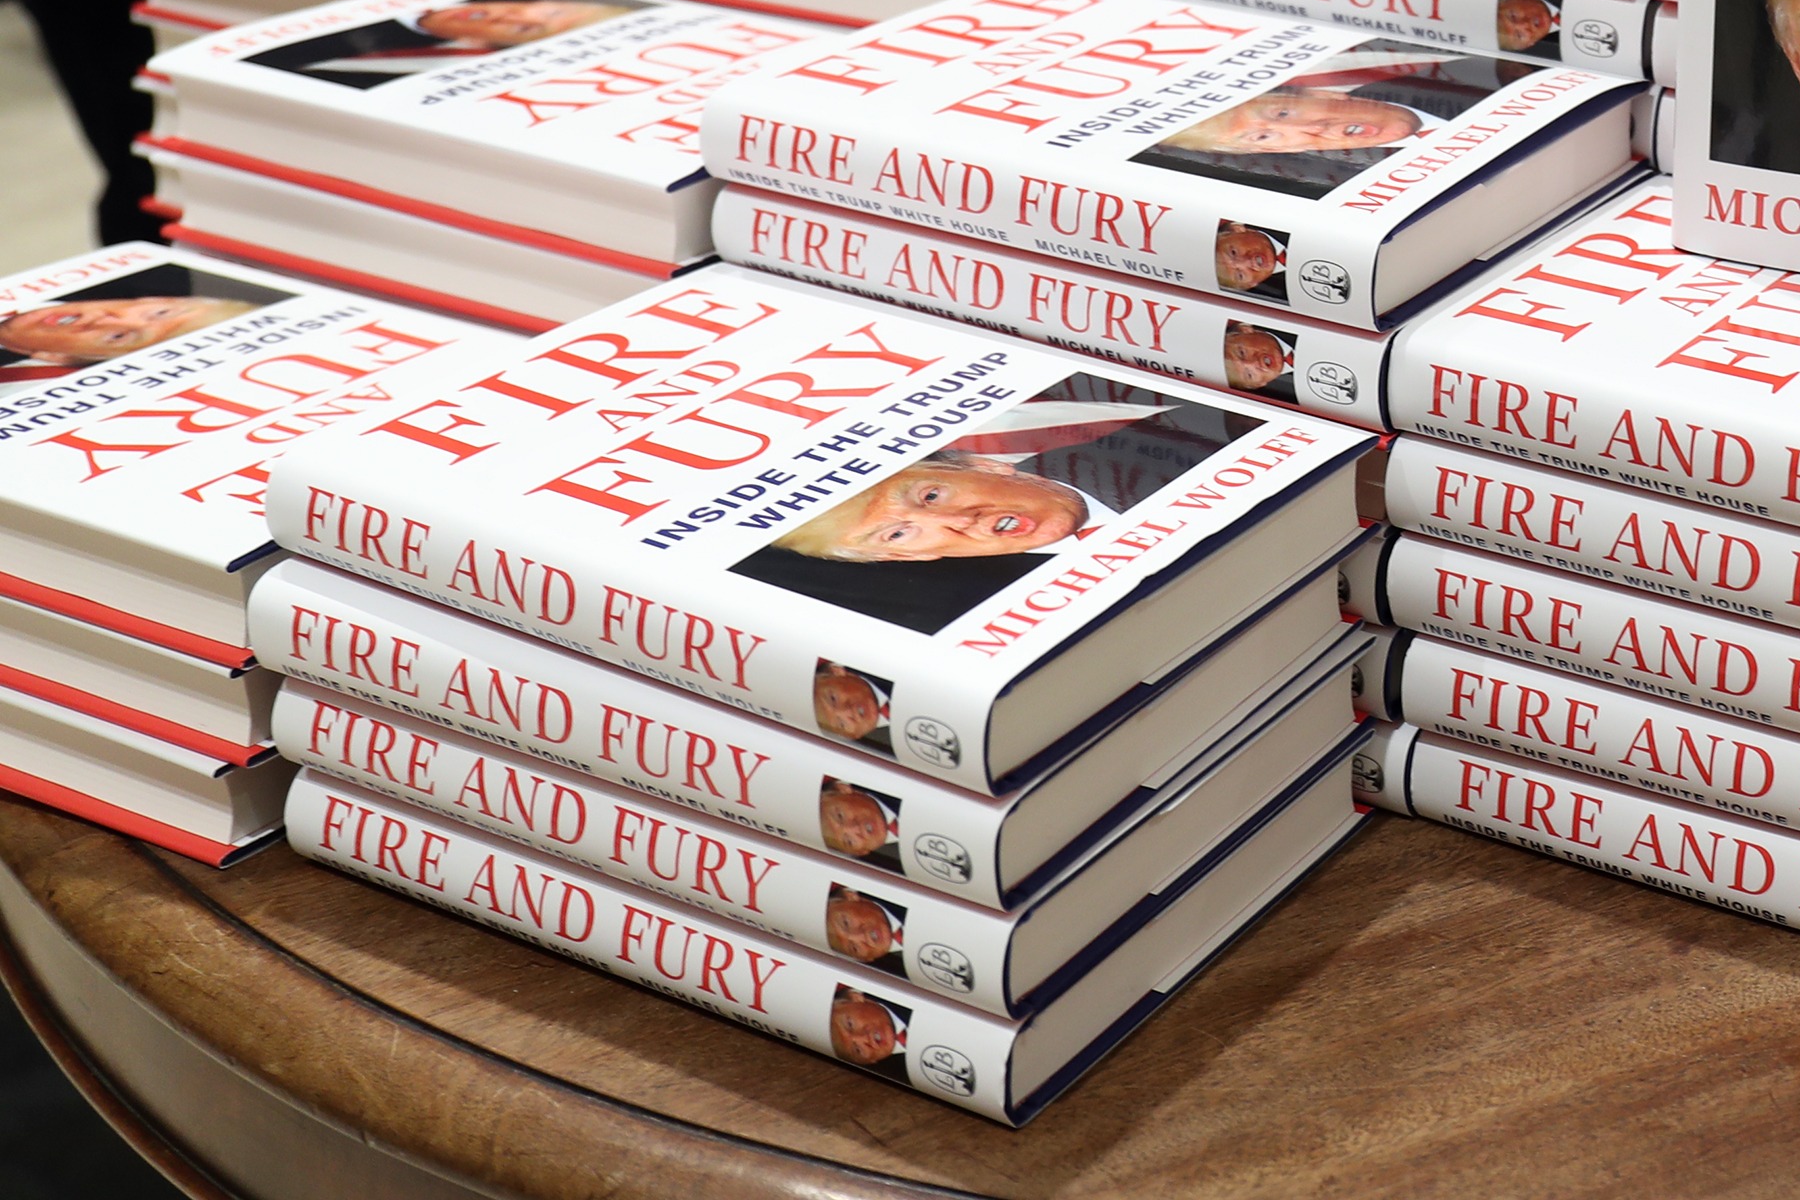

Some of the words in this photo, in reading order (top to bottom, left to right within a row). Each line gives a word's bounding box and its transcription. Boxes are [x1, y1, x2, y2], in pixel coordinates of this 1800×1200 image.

[480, 22, 812, 128] FURY
[934, 6, 1260, 133] FURY
[977, 30, 1087, 76] AND
[1046, 99, 1161, 149] INSIDE
[1155, 69, 1225, 97] THE
[1218, 24, 1316, 66] TRUMP
[1122, 92, 1233, 136] WHITE
[1227, 42, 1330, 90] HOUSE
[736, 115, 857, 186] FIRE
[872, 147, 994, 214] AND
[1015, 175, 1172, 254] FURY
[1340, 124, 1509, 213] MICHAEL
[1489, 69, 1601, 118] WOLFF
[728, 169, 783, 189] INSIDE
[788, 182, 821, 198] THE
[827, 192, 882, 211] TRUMP
[889, 206, 944, 226] WHITE
[951, 220, 1009, 242] HOUSE
[1035, 239, 1117, 267] MICHAEL
[1122, 259, 1184, 281] WOLFF
[147, 315, 290, 362] WHITE
[226, 306, 367, 354] INSIDE
[752, 208, 868, 279] FIRE
[886, 243, 1005, 310] AND
[1028, 273, 1181, 352] FURY
[0, 392, 127, 440] TRUM
[28, 320, 458, 483] FURY
[135, 357, 226, 392] THE
[245, 383, 393, 443] AND
[358, 288, 782, 466] FIRE
[522, 322, 946, 527] FURY
[594, 359, 741, 434] AND
[1428, 364, 1578, 449] FIRE
[1600, 409, 1755, 488] AND
[640, 468, 796, 550] INSIDE
[793, 419, 884, 463] THE
[883, 351, 1009, 418] TRUMP
[736, 457, 880, 531] WHITE
[880, 383, 1016, 452] HOUSE
[1415, 422, 1482, 448] INSIDE
[1490, 441, 1531, 459] THE
[1539, 452, 1610, 478] TRUMP
[1618, 472, 1686, 497] WHITE
[1696, 490, 1770, 517] HOUSE
[305, 486, 430, 579] FIRE
[448, 540, 576, 626] AND
[600, 585, 766, 691] FURY
[957, 518, 1188, 658] MICHAEL
[1168, 427, 1320, 513] WOLFF
[1434, 568, 1583, 654] FIRE
[1604, 617, 1759, 697] AND
[290, 605, 421, 698] FIRE
[440, 658, 574, 744] AND
[599, 704, 769, 808] FURY
[1456, 760, 1603, 849] FIRE
[1623, 814, 1776, 896] AND
[320, 795, 450, 892] FIRE
[464, 854, 595, 943] AND
[617, 904, 785, 1014] FURY
